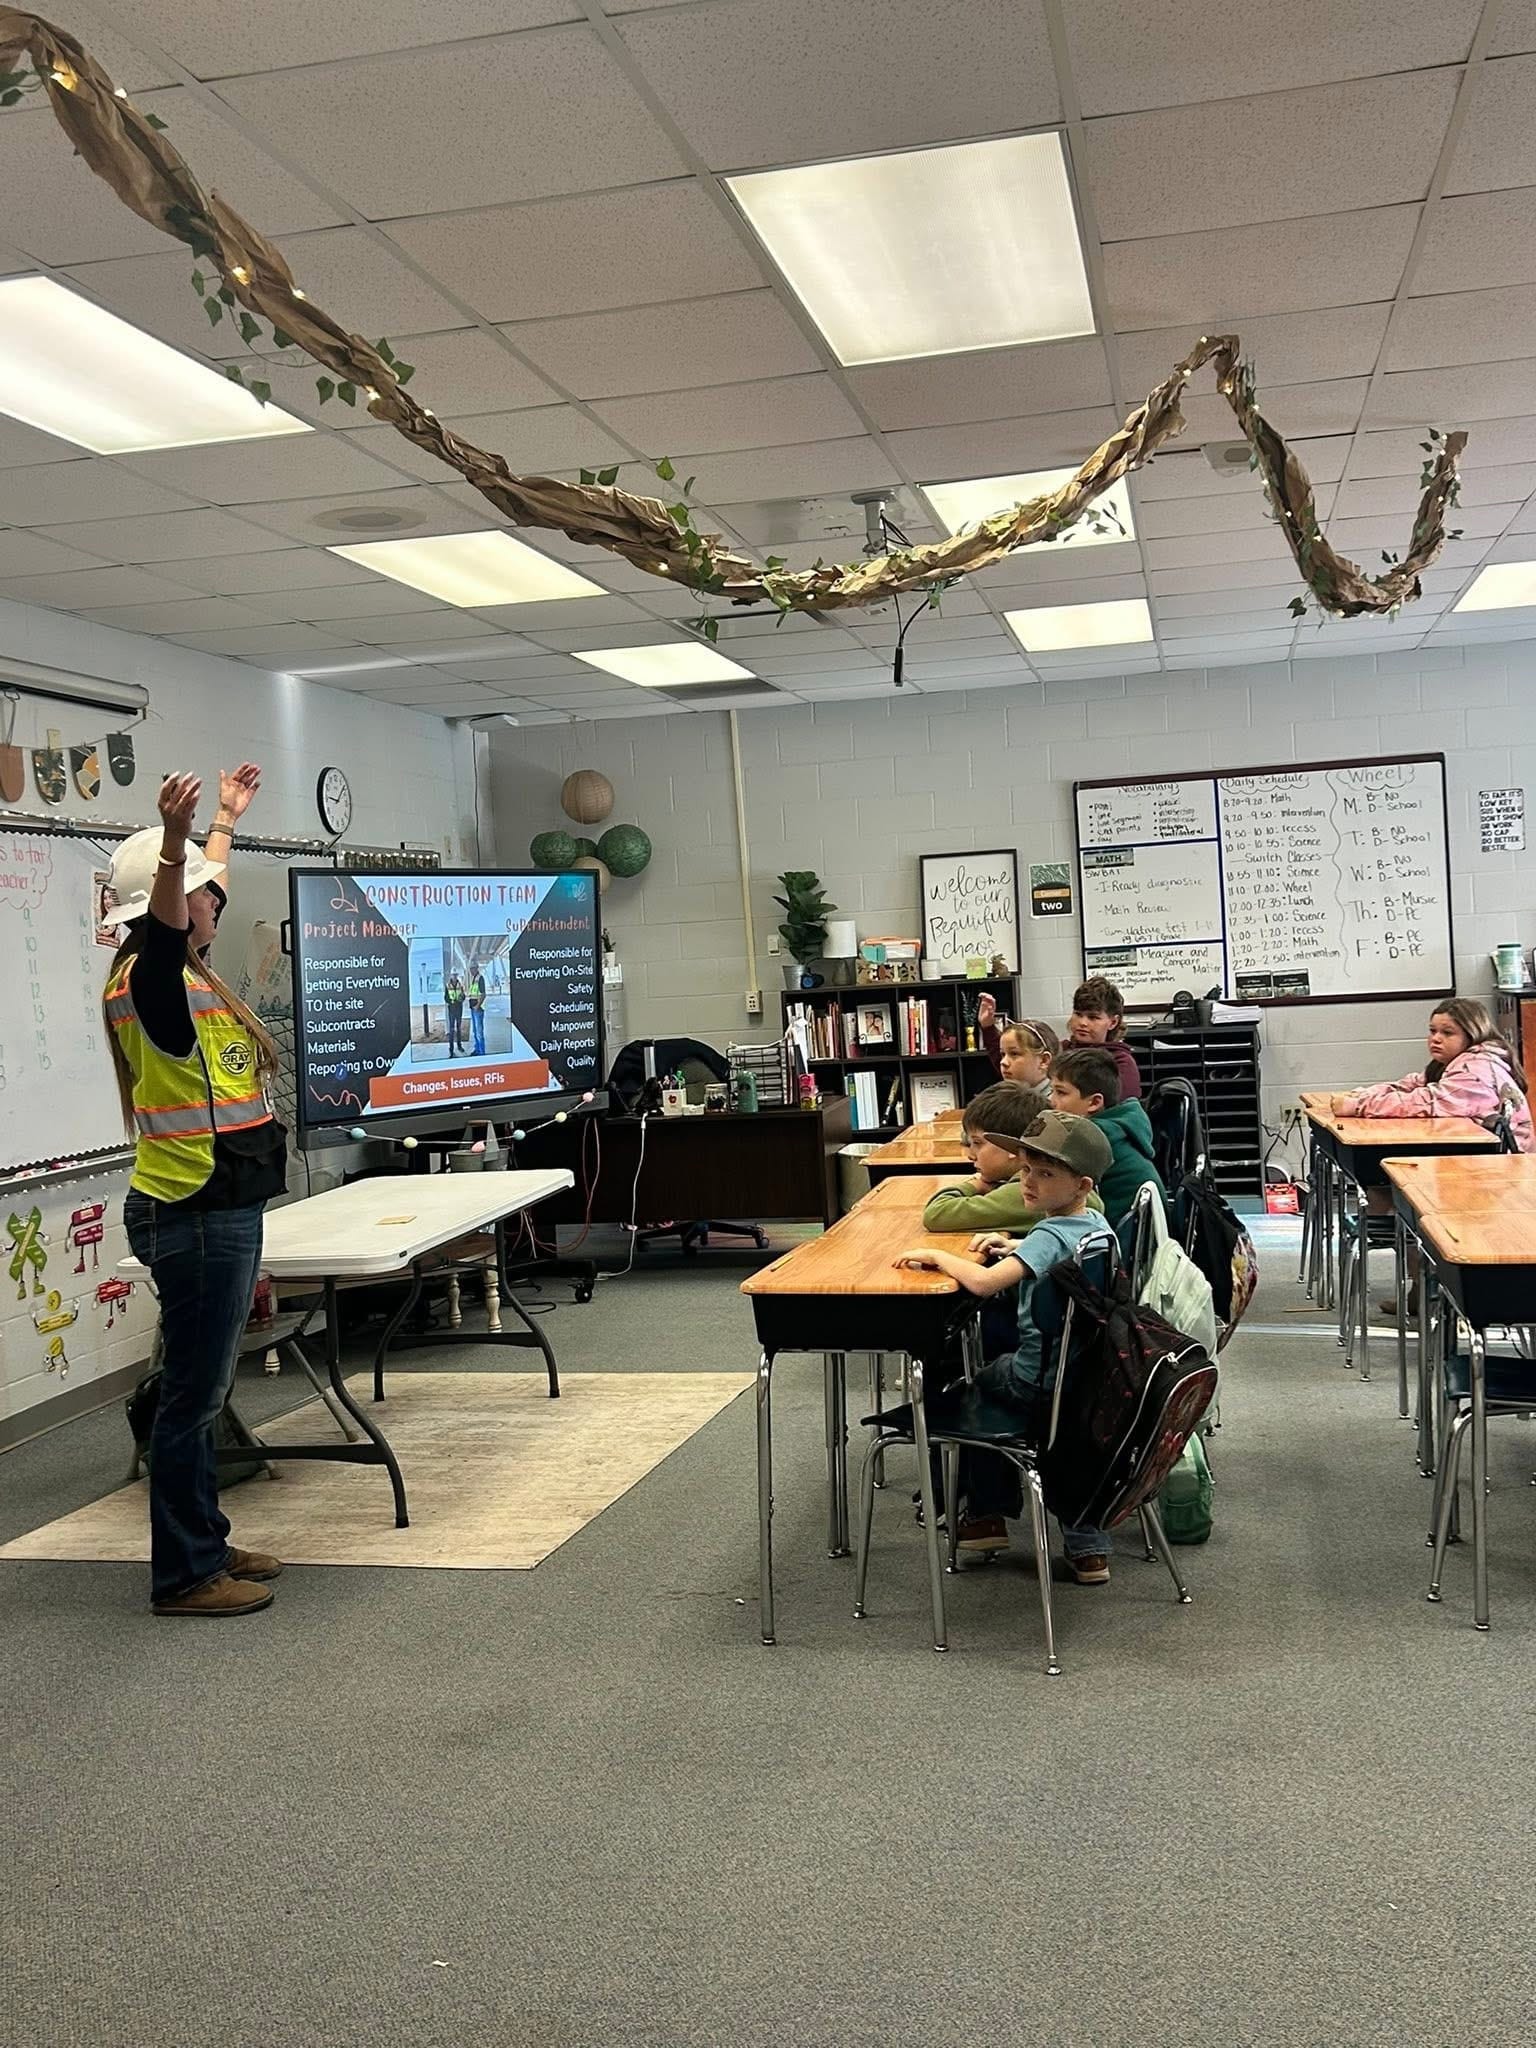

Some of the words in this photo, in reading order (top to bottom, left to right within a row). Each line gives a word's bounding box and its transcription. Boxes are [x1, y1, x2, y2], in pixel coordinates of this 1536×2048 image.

[1225, 778, 1254, 788] Daily
[1259, 774, 1303, 785] Schedule
[1347, 765, 1402, 783] Wheel
[1270, 793, 1292, 803] Math
[1387, 799, 1423, 811] School
[1288, 835, 1321, 848] Science
[1392, 831, 1431, 845] School
[12, 839, 24, 862] to
[1245, 852, 1283, 863] Switch
[1287, 850, 1322, 864] Classes
[1095, 855, 1122, 864] MATH
[1287, 864, 1320, 877] Science
[930, 865, 1012, 901] welcome
[365, 884, 491, 908] CONSTRUCTION
[497, 884, 537, 906] TEAM
[954, 895, 968, 913] to
[974, 888, 1002, 906] our
[1041, 901, 1063, 911] two
[929, 896, 1013, 943] Beautiful
[1292, 909, 1326, 921] Science
[303, 920, 358, 939] Project
[362, 919, 418, 938] Manager
[505, 916, 591, 933] Superintendent
[942, 931, 998, 963] chaos
[1292, 937, 1319, 948] Math
[529, 947, 580, 960] Responsible
[581, 946, 593, 957] for
[1095, 954, 1130, 964] SCIENCE
[1140, 949, 1183, 960] Measure
[1190, 947, 1208, 957] and
[304, 956, 369, 972] Responsible
[371, 955, 386, 968] for
[515, 966, 560, 980] Everything
[305, 977, 343, 994] getting
[346, 975, 400, 990] Everything
[567, 983, 594, 995] Safety
[305, 999, 323, 1012] TO
[325, 998, 343, 1011] the
[345, 997, 364, 1010] site
[549, 1002, 594, 1014] Scheduling
[306, 1018, 376, 1034] Subcontracts
[551, 1021, 595, 1033] Manpower
[307, 1039, 356, 1055] Materials
[540, 1040, 562, 1052] Daily
[563, 1038, 595, 1050] Reports
[222, 1053, 250, 1064] GRAY
[362, 1058, 374, 1070] to
[566, 1055, 596, 1069] Quality
[403, 1081, 449, 1095] Changes,
[450, 1076, 482, 1089] Issues,
[484, 1072, 505, 1085] RFIs
